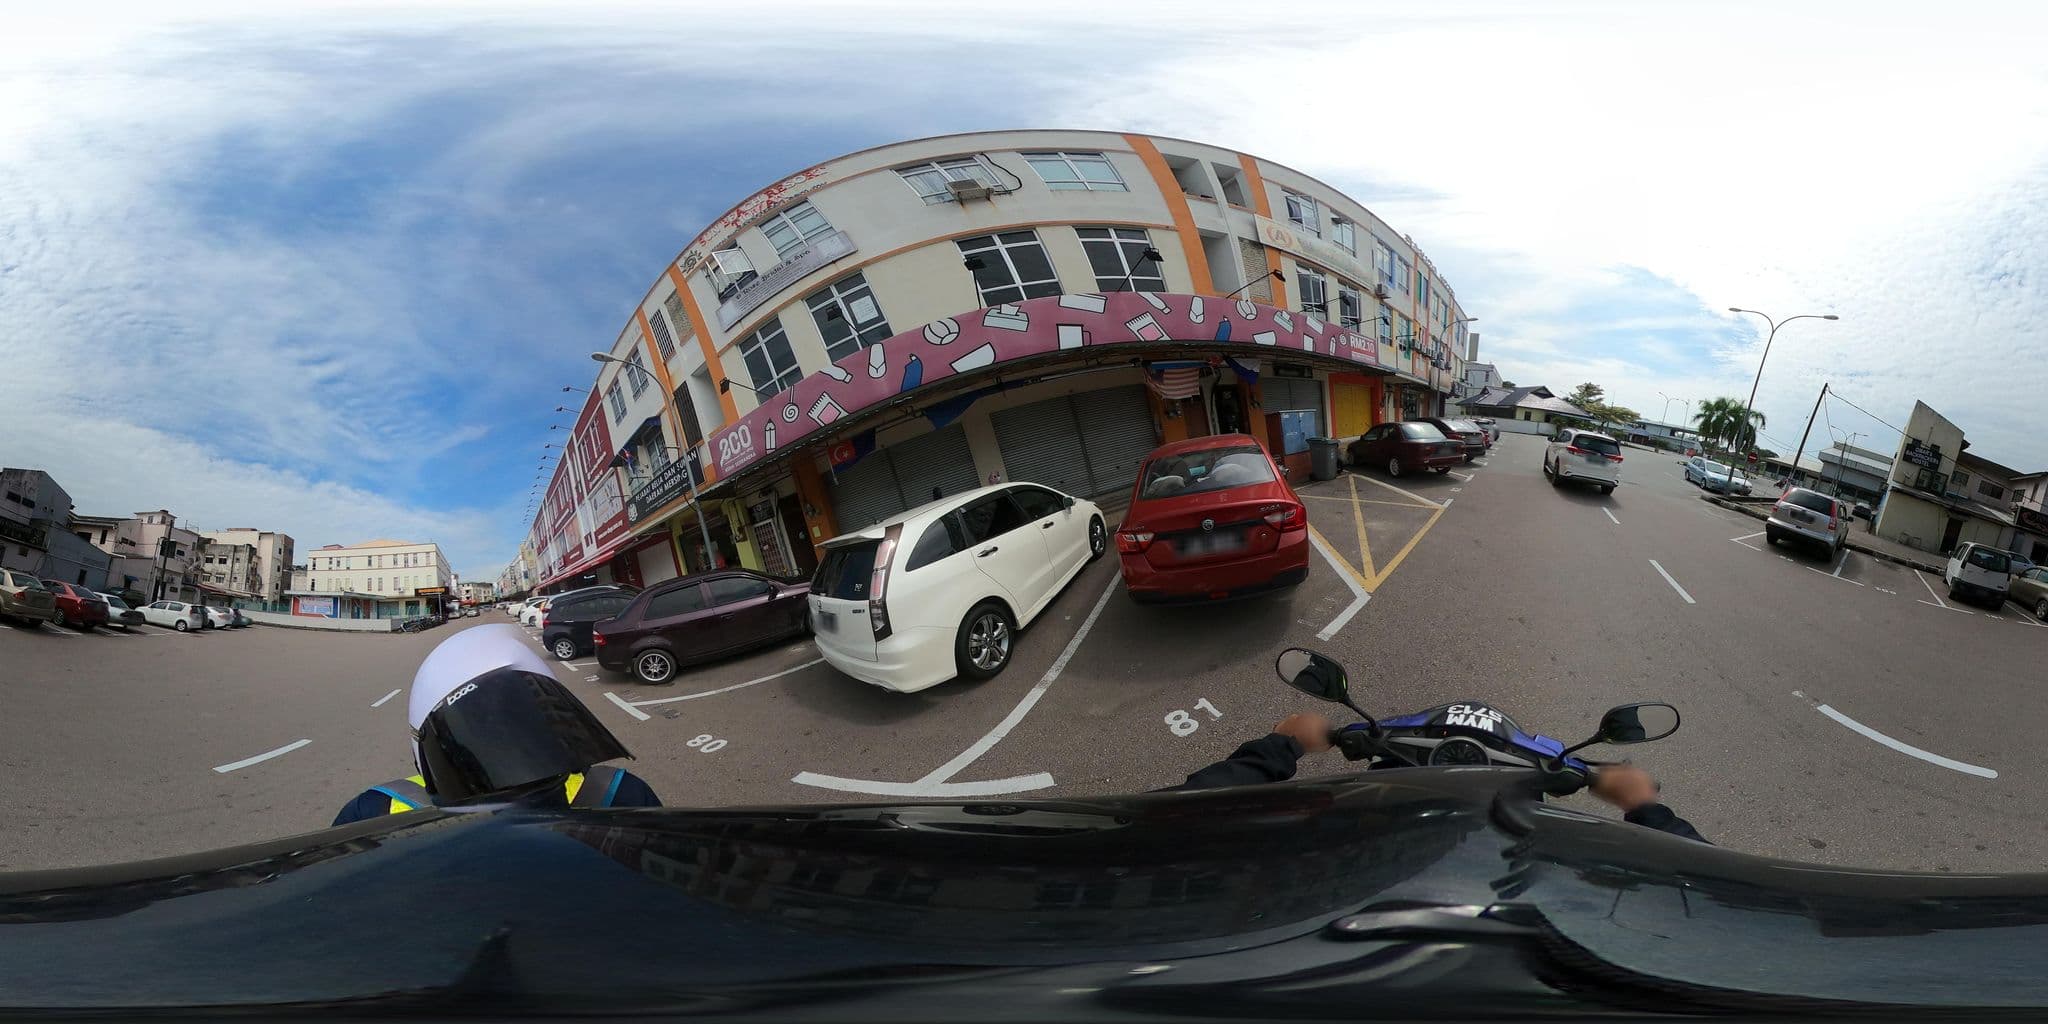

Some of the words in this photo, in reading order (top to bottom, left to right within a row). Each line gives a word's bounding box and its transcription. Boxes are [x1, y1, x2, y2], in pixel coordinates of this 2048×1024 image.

[1350, 335, 1375, 353] RM2.10
[664, 467, 676, 481] DAN
[676, 450, 698, 472] SUAN
[1164, 697, 1223, 737] 81
[1445, 713, 1494, 732] WYM
[1446, 704, 1502, 723] 5713
[686, 734, 728, 753] 80
